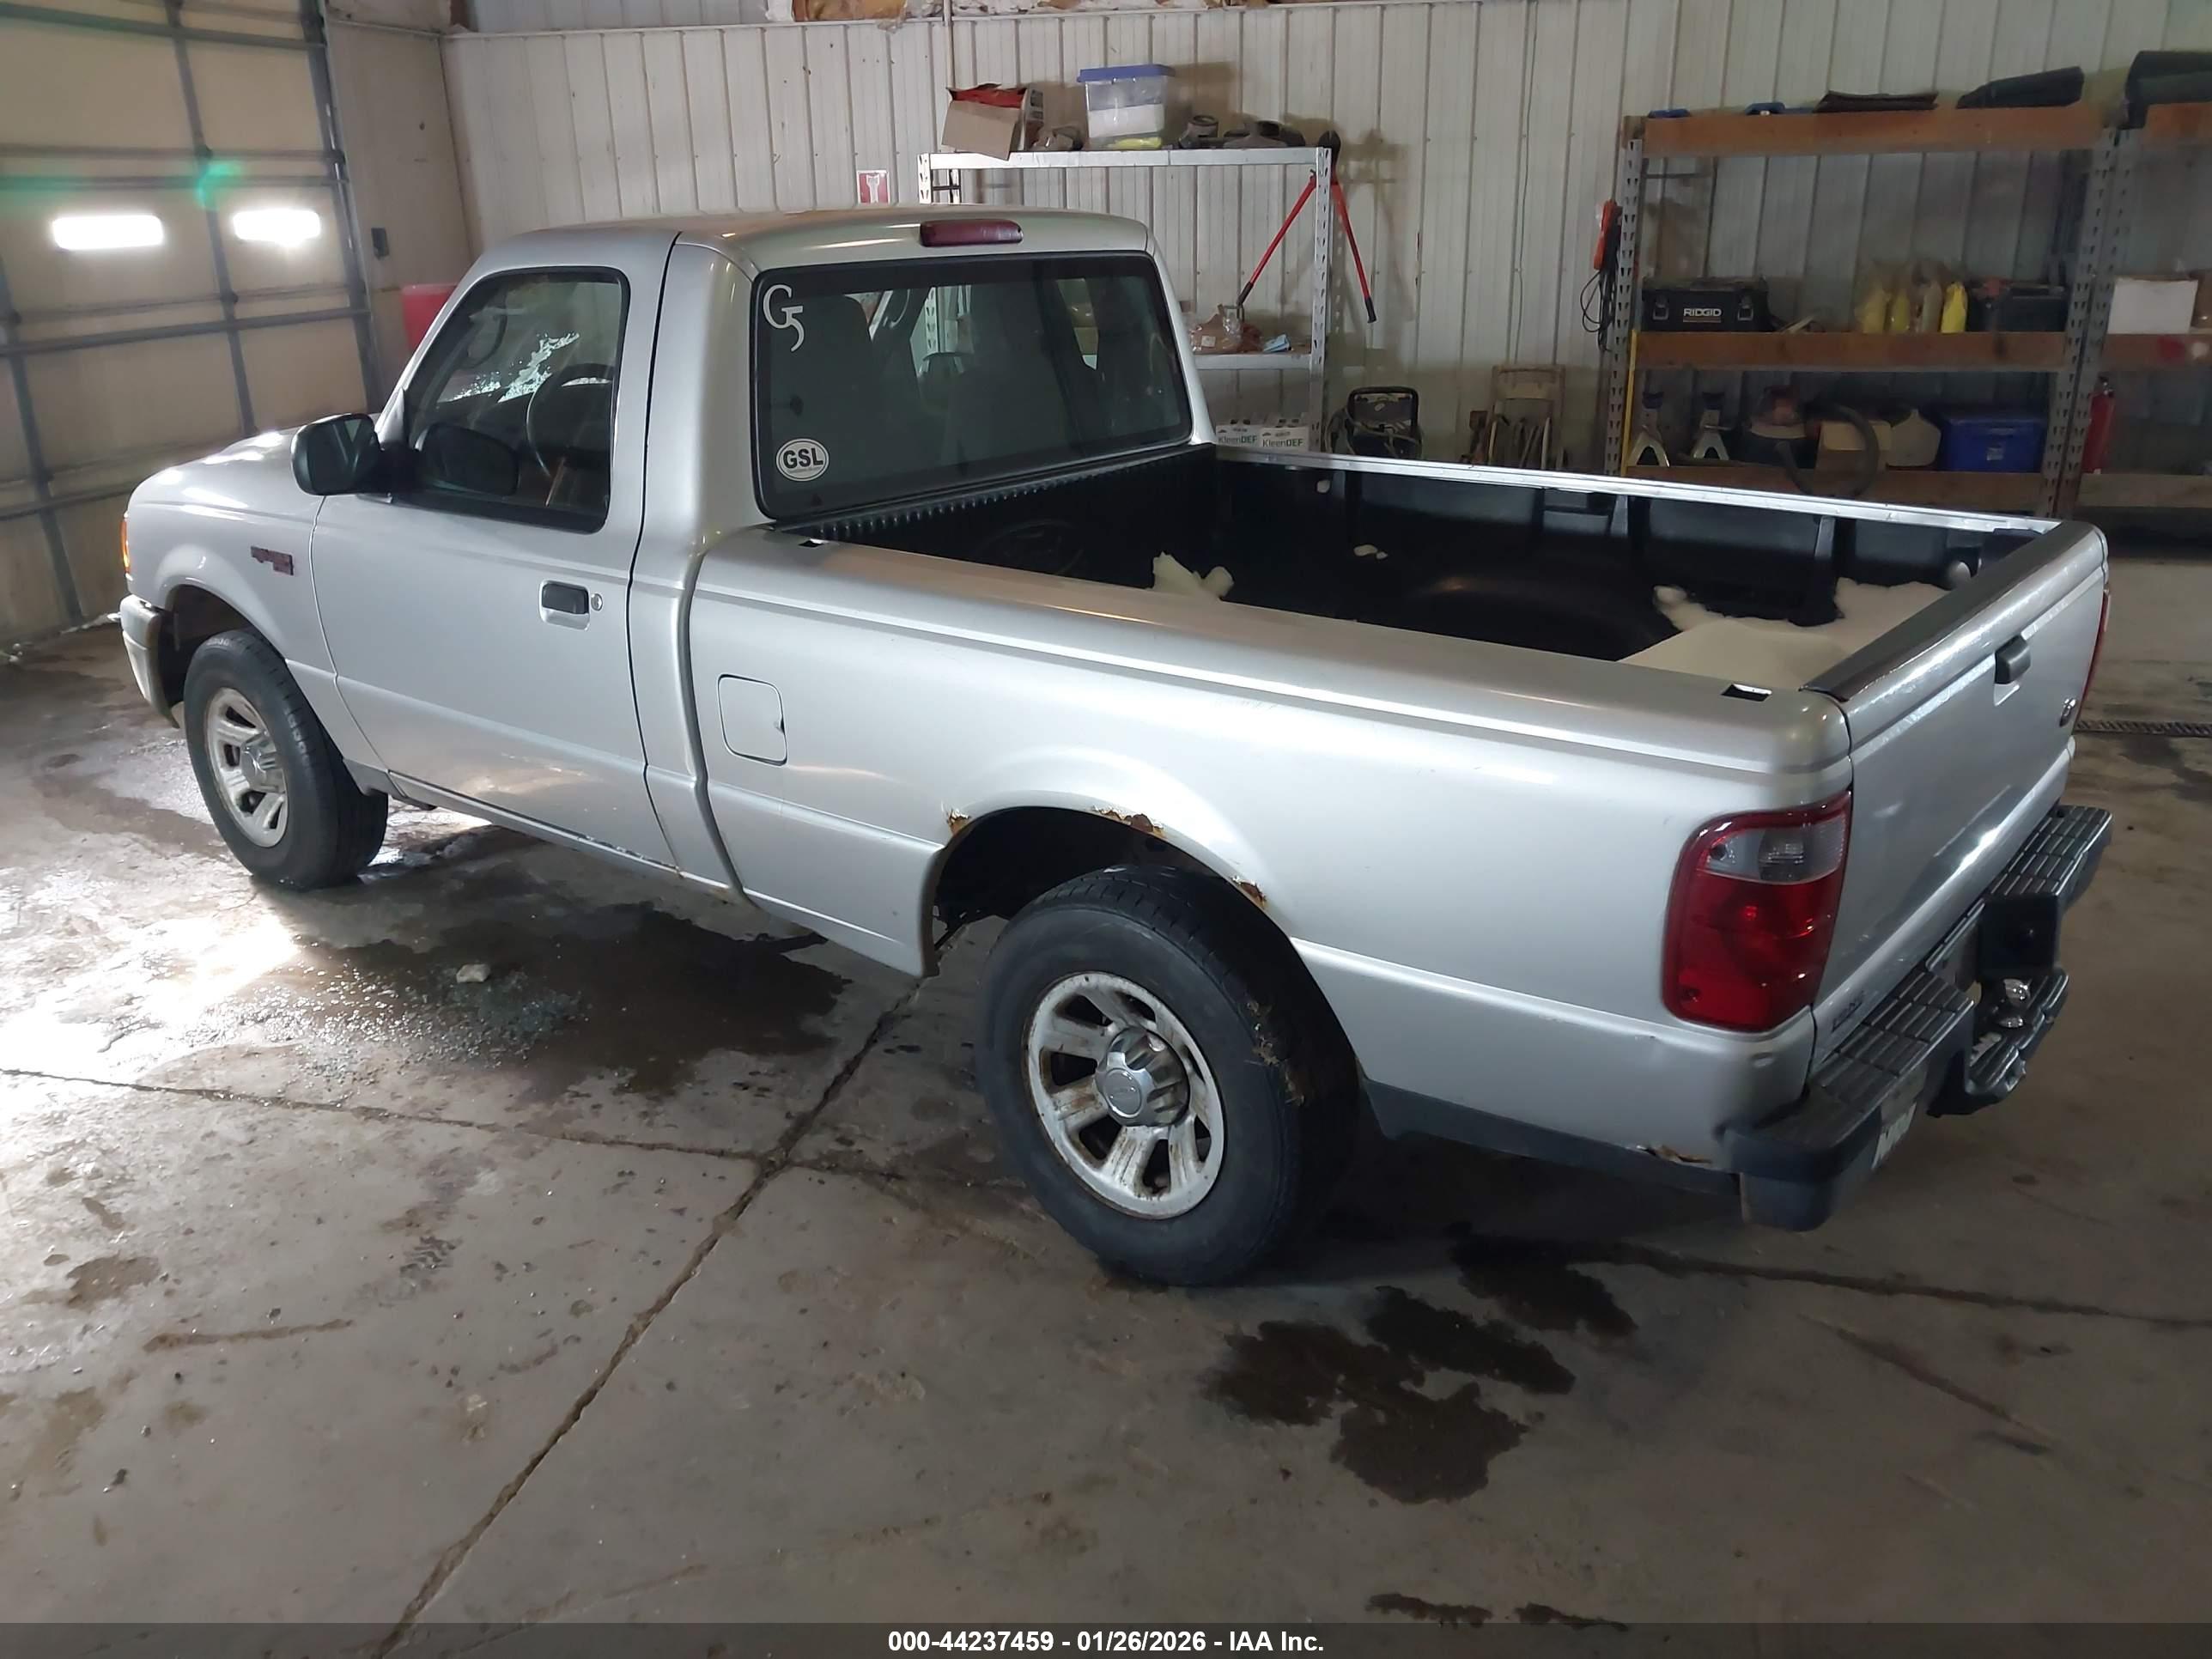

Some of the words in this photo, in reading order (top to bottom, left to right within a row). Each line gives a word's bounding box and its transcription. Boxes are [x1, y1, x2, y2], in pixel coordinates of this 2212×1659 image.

[1683, 308, 1722, 317] RIDGID
[1262, 438, 1304, 447] KleenDEF
[782, 447, 823, 469] GSL
